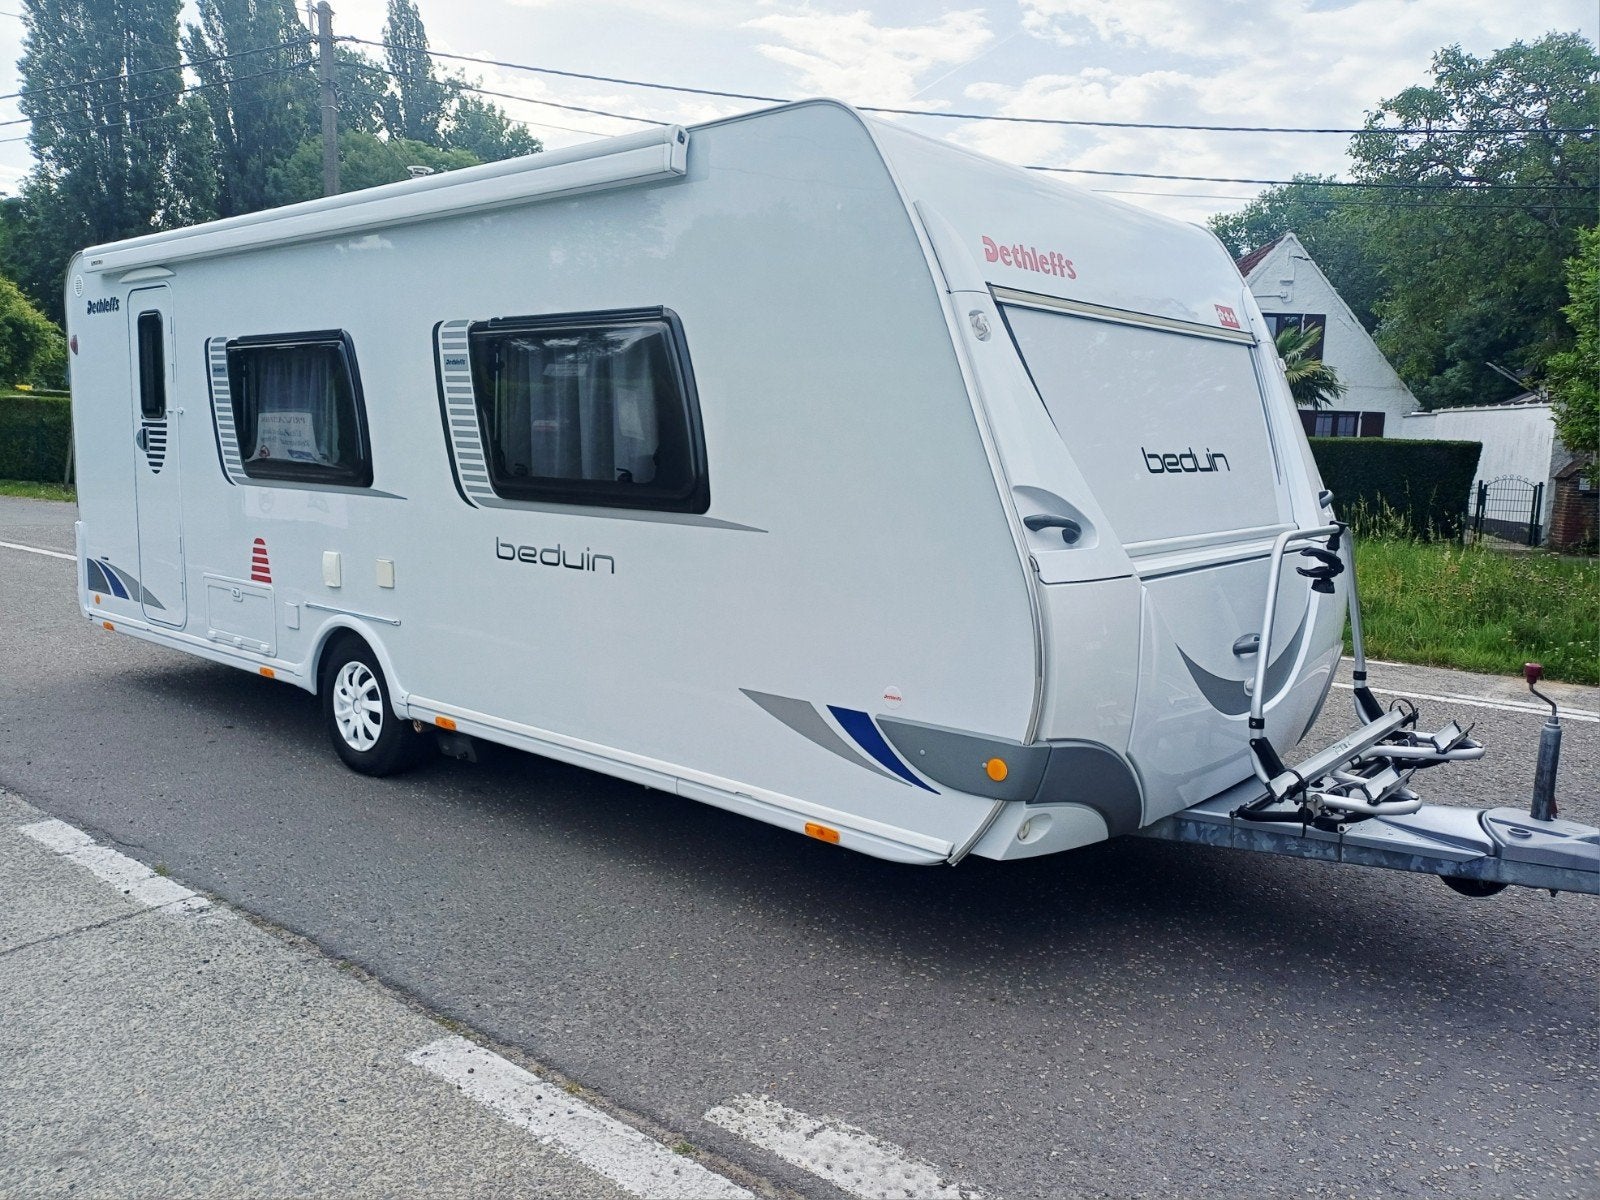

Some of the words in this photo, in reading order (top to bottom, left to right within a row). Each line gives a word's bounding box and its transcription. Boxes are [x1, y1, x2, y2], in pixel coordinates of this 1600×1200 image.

[982, 235, 1077, 280] Dethleffs
[87, 296, 120, 315] Dethleffs
[1141, 446, 1231, 473] beduin
[496, 536, 615, 574] beduin
